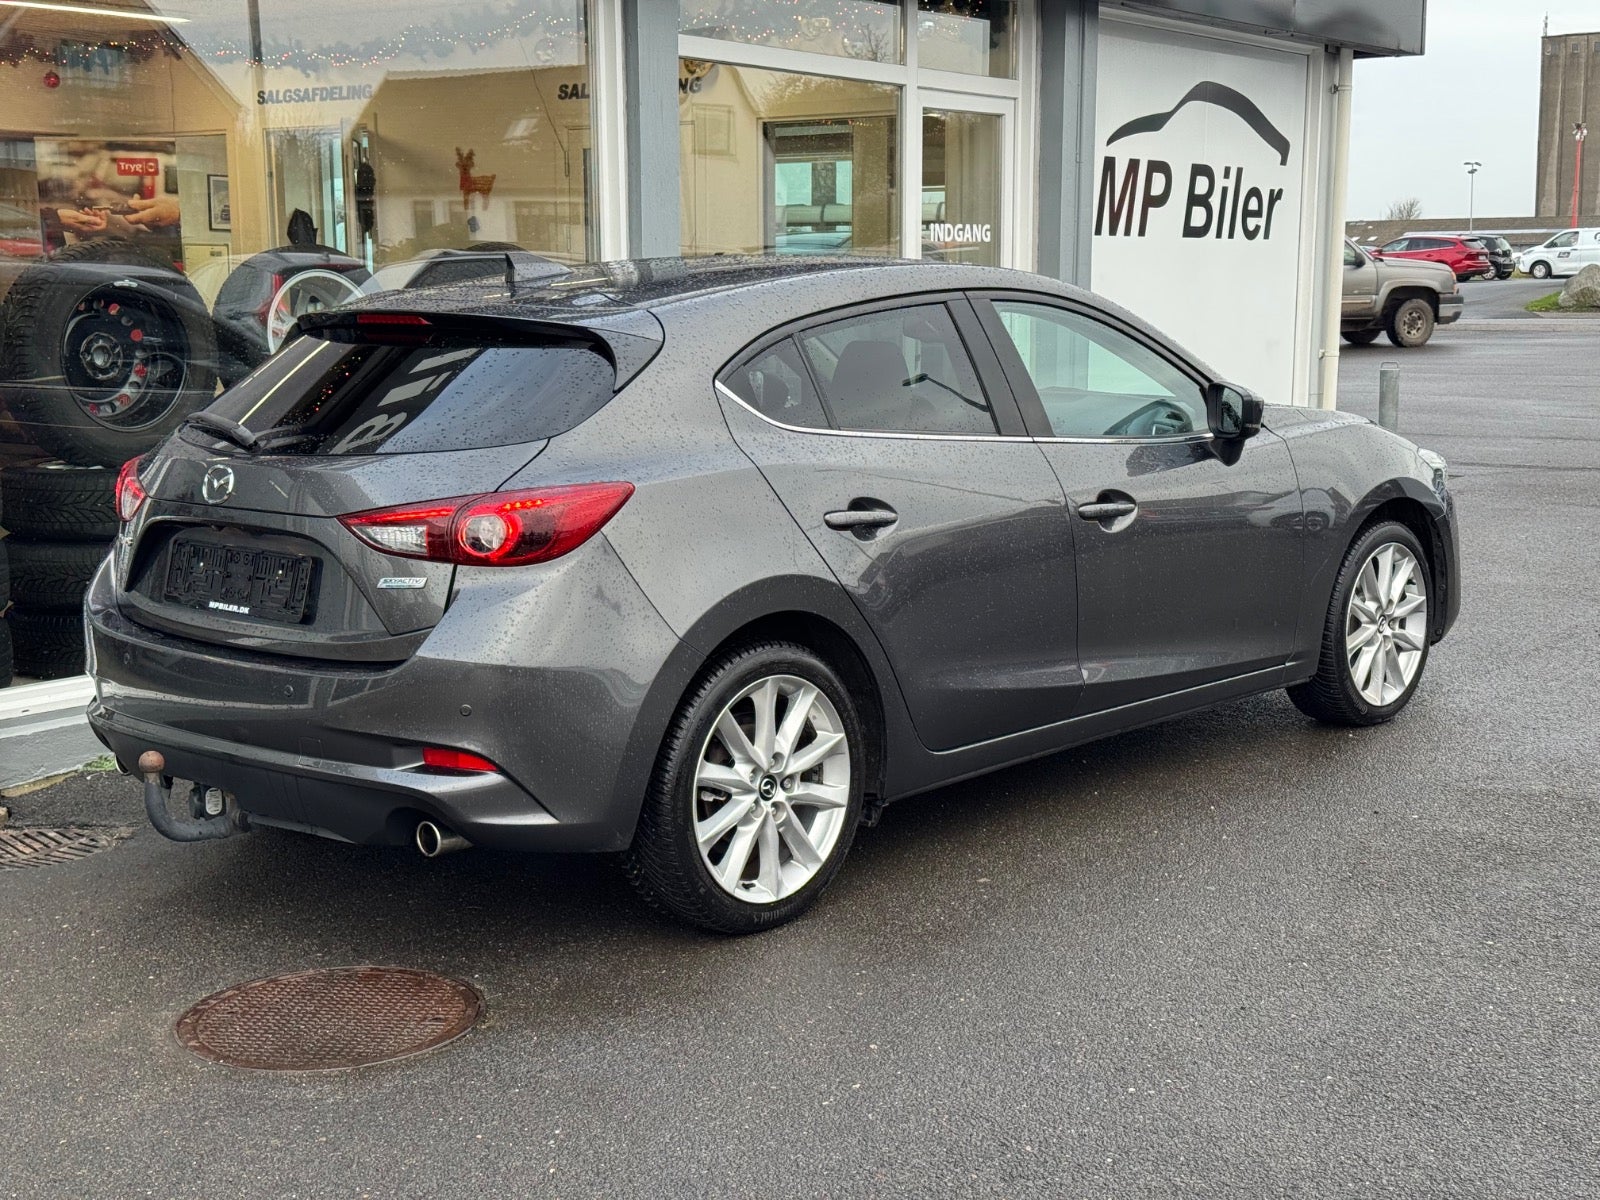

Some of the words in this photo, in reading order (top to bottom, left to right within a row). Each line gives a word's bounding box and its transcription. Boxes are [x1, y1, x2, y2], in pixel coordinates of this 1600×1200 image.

[257, 84, 373, 105] SALGSAFDELING
[119, 162, 142, 172] Tryg
[1094, 156, 1173, 237] MP
[1182, 163, 1284, 240] Biler
[930, 223, 991, 242] INDGANG
[208, 601, 250, 614] MPBILER.DK
